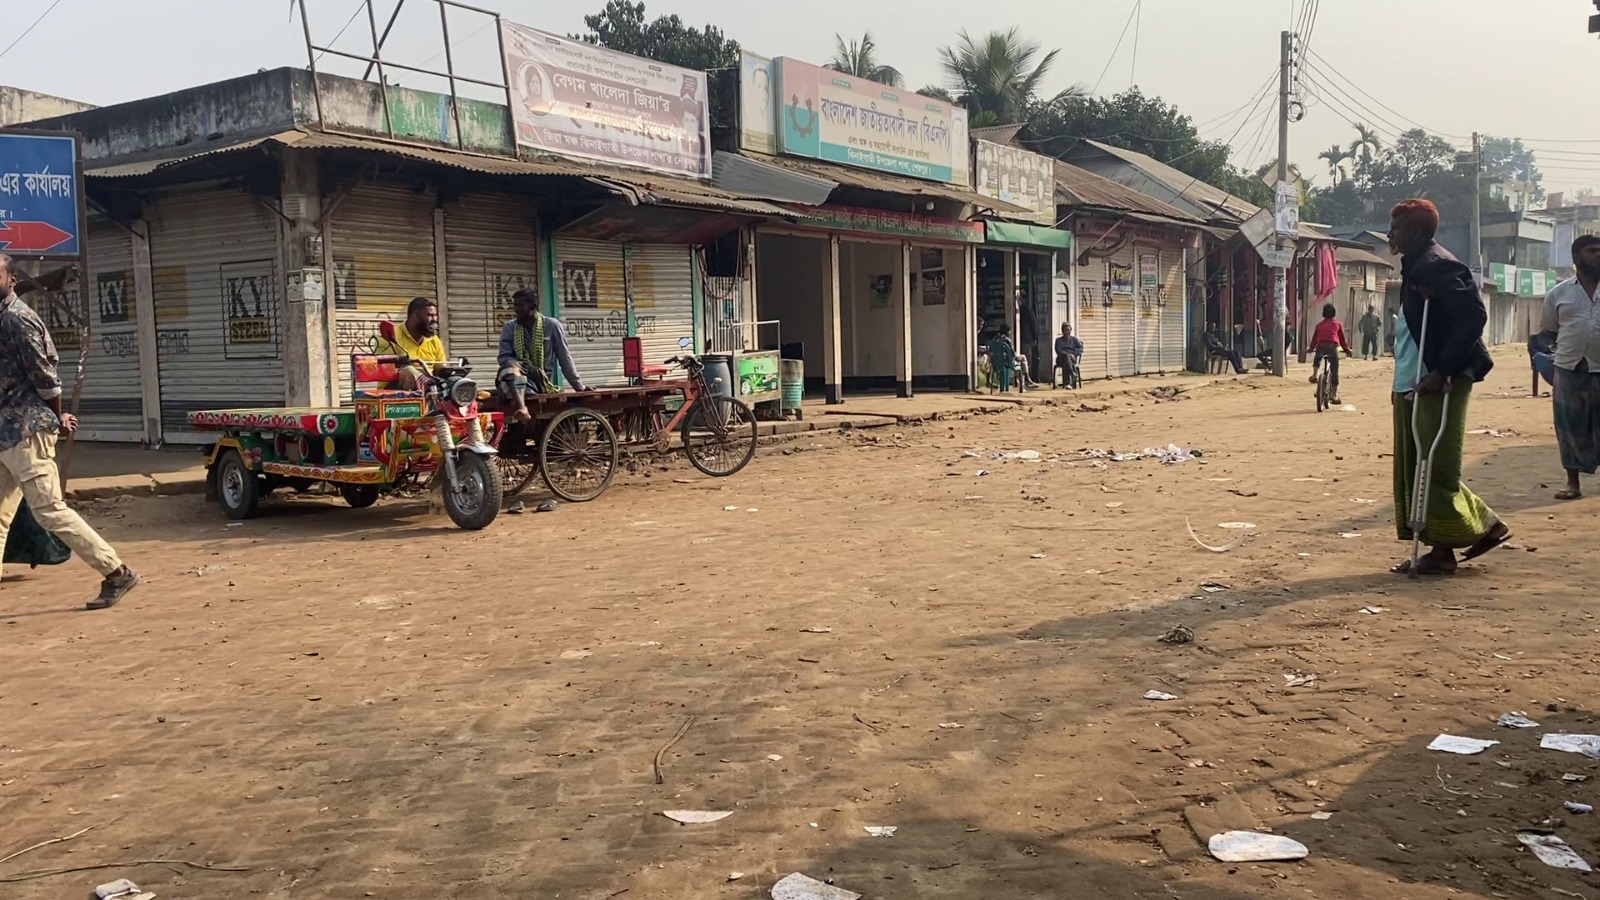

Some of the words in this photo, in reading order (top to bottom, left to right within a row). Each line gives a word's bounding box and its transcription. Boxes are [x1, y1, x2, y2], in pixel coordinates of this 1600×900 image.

[553, 73, 587, 94] বেগম
[590, 82, 630, 106] খালেদা
[543, 129, 561, 141] জিয়া
[820, 97, 858, 128] বাংলাদেশ
[859, 101, 905, 140] জাতীয়তাবাদী
[907, 119, 918, 141] দল
[920, 115, 950, 154] (বিএনপি)
[22, 164, 72, 198] কার্যালয়
[100, 279, 125, 316] KY
[227, 275, 270, 318] KY
[564, 268, 594, 301] KY
[231, 320, 269, 340] STEEL
